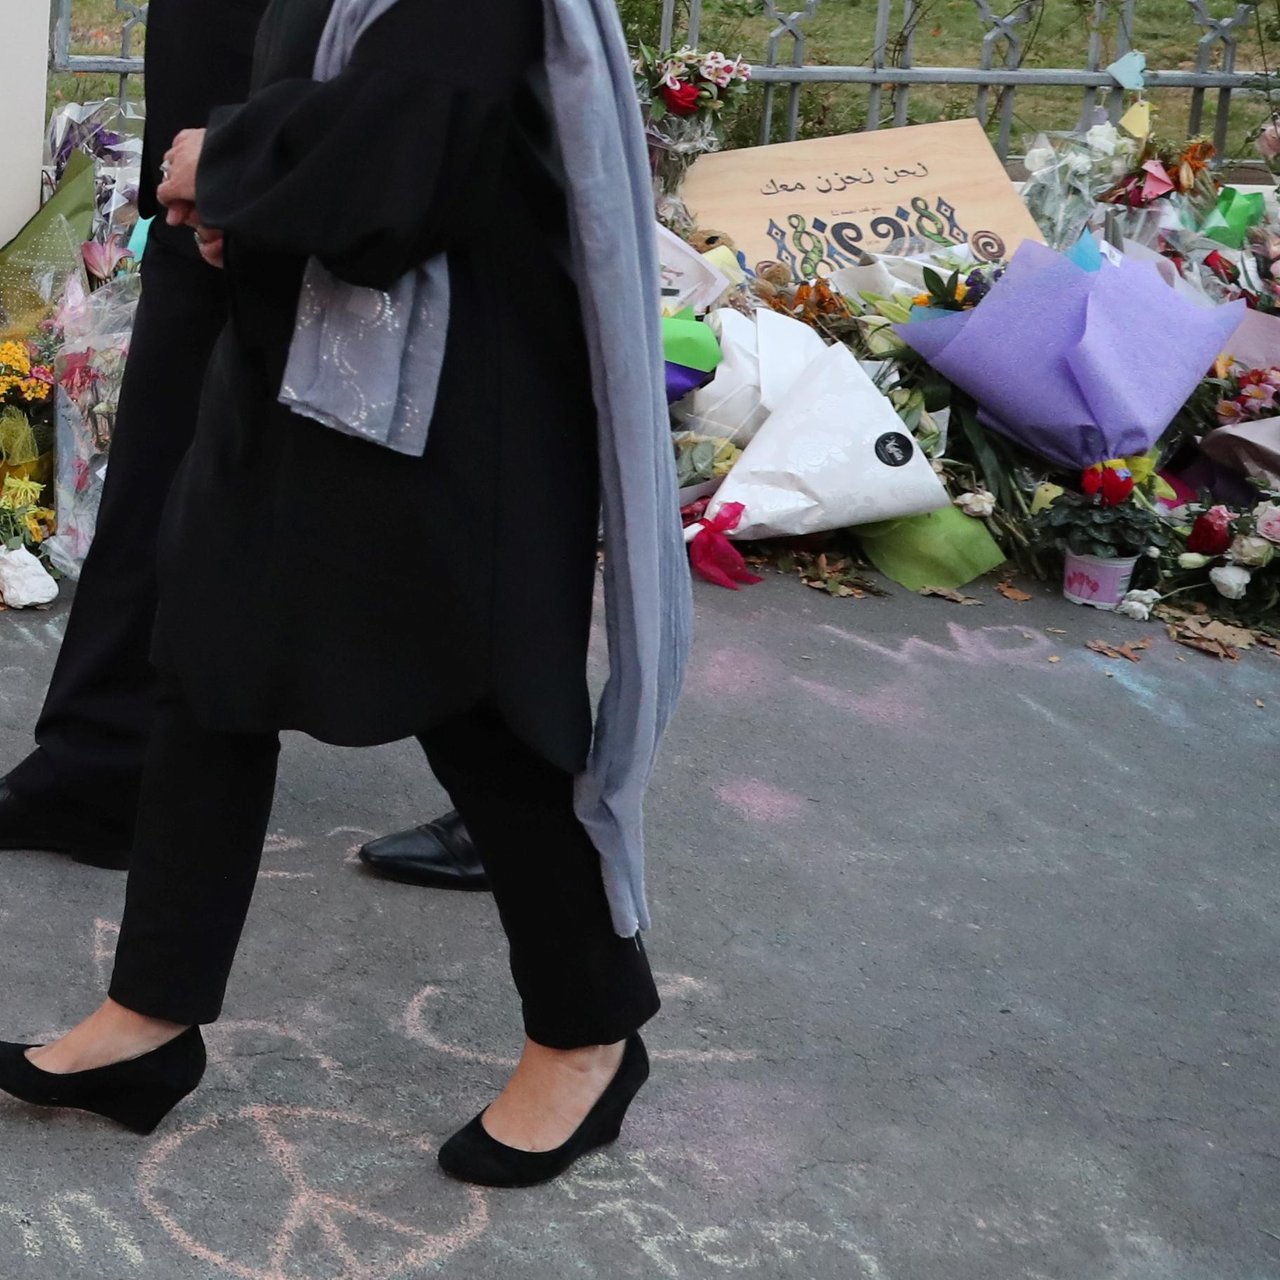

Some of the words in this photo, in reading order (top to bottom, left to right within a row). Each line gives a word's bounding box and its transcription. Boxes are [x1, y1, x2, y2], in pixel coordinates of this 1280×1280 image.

[815, 167, 875, 195] نحزن
[882, 161, 929, 186] نحن
[759, 177, 808, 197] معك
